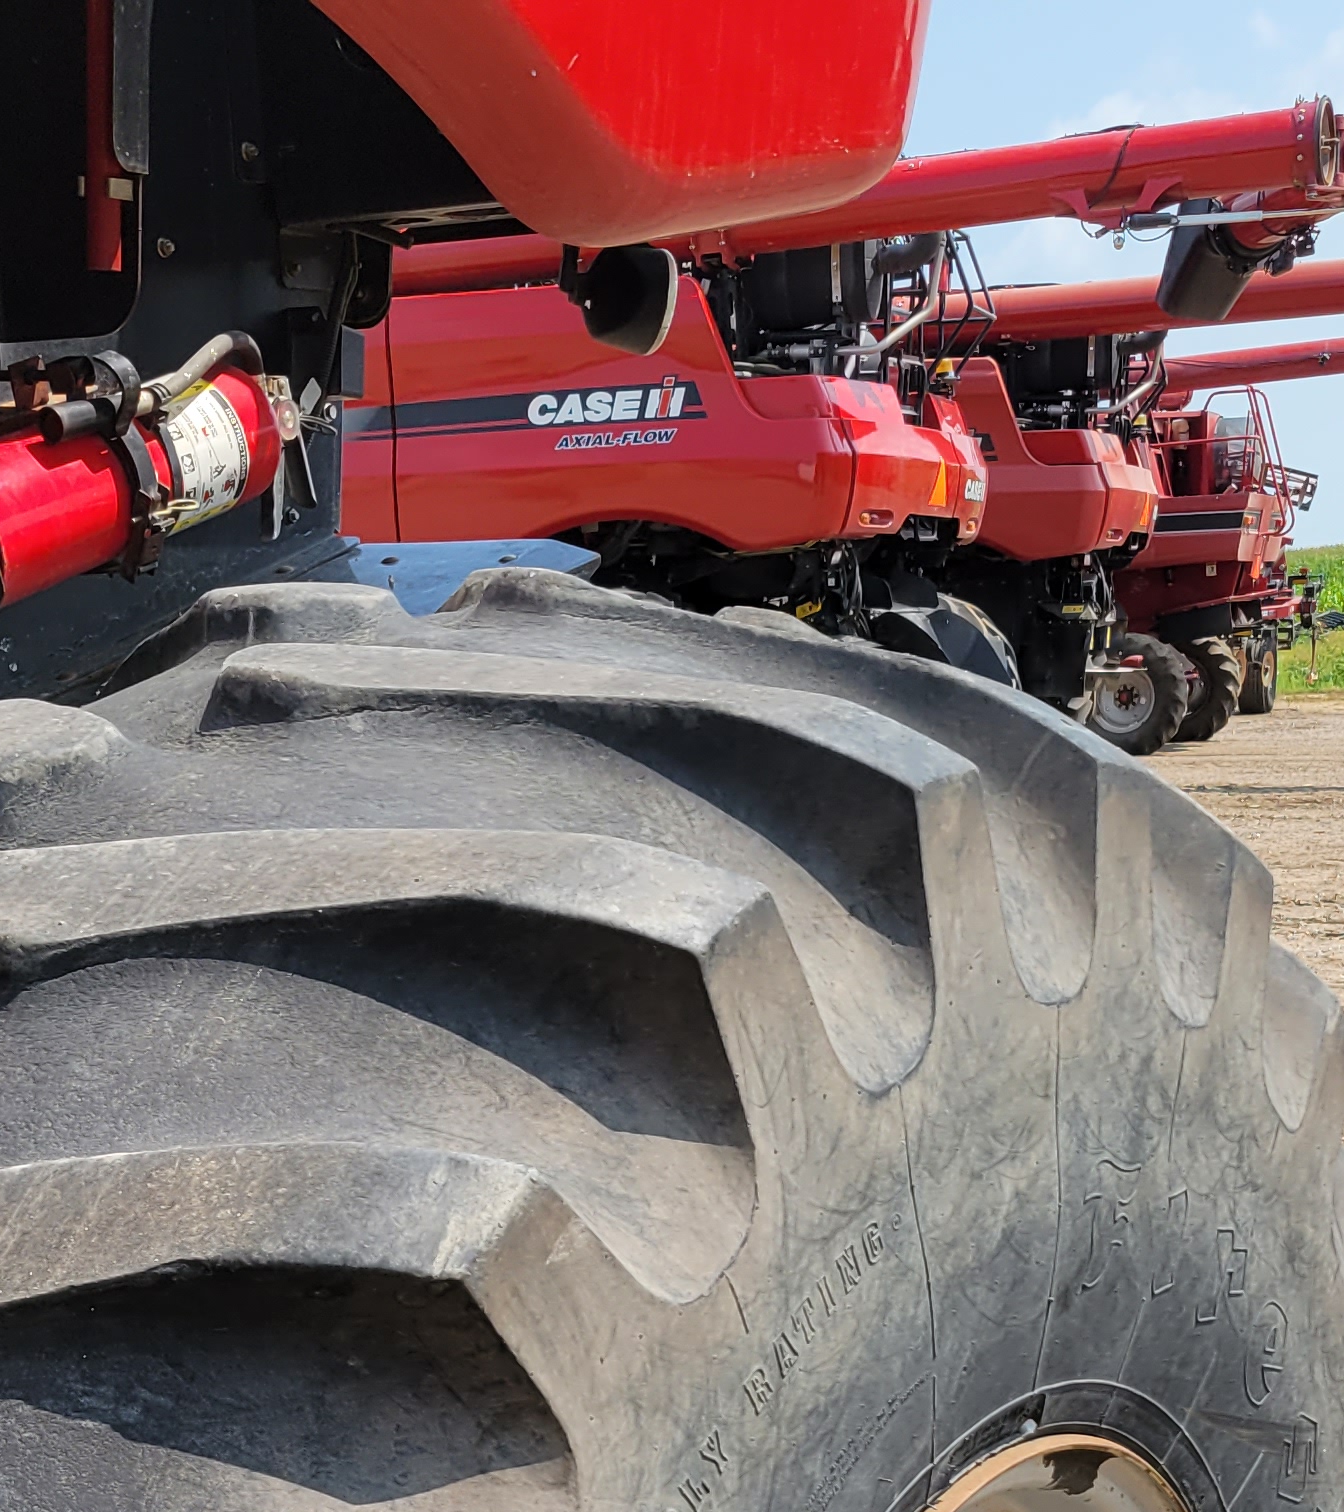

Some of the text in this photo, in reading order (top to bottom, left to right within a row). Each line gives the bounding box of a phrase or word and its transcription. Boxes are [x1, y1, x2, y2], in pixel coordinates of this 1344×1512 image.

[527, 376, 687, 426] CASE IH
[224, 407, 249, 480] INSTRUCTIONS
[556, 428, 677, 450] AXIAL-FLOW
[746, 1221, 884, 1417] RATING
